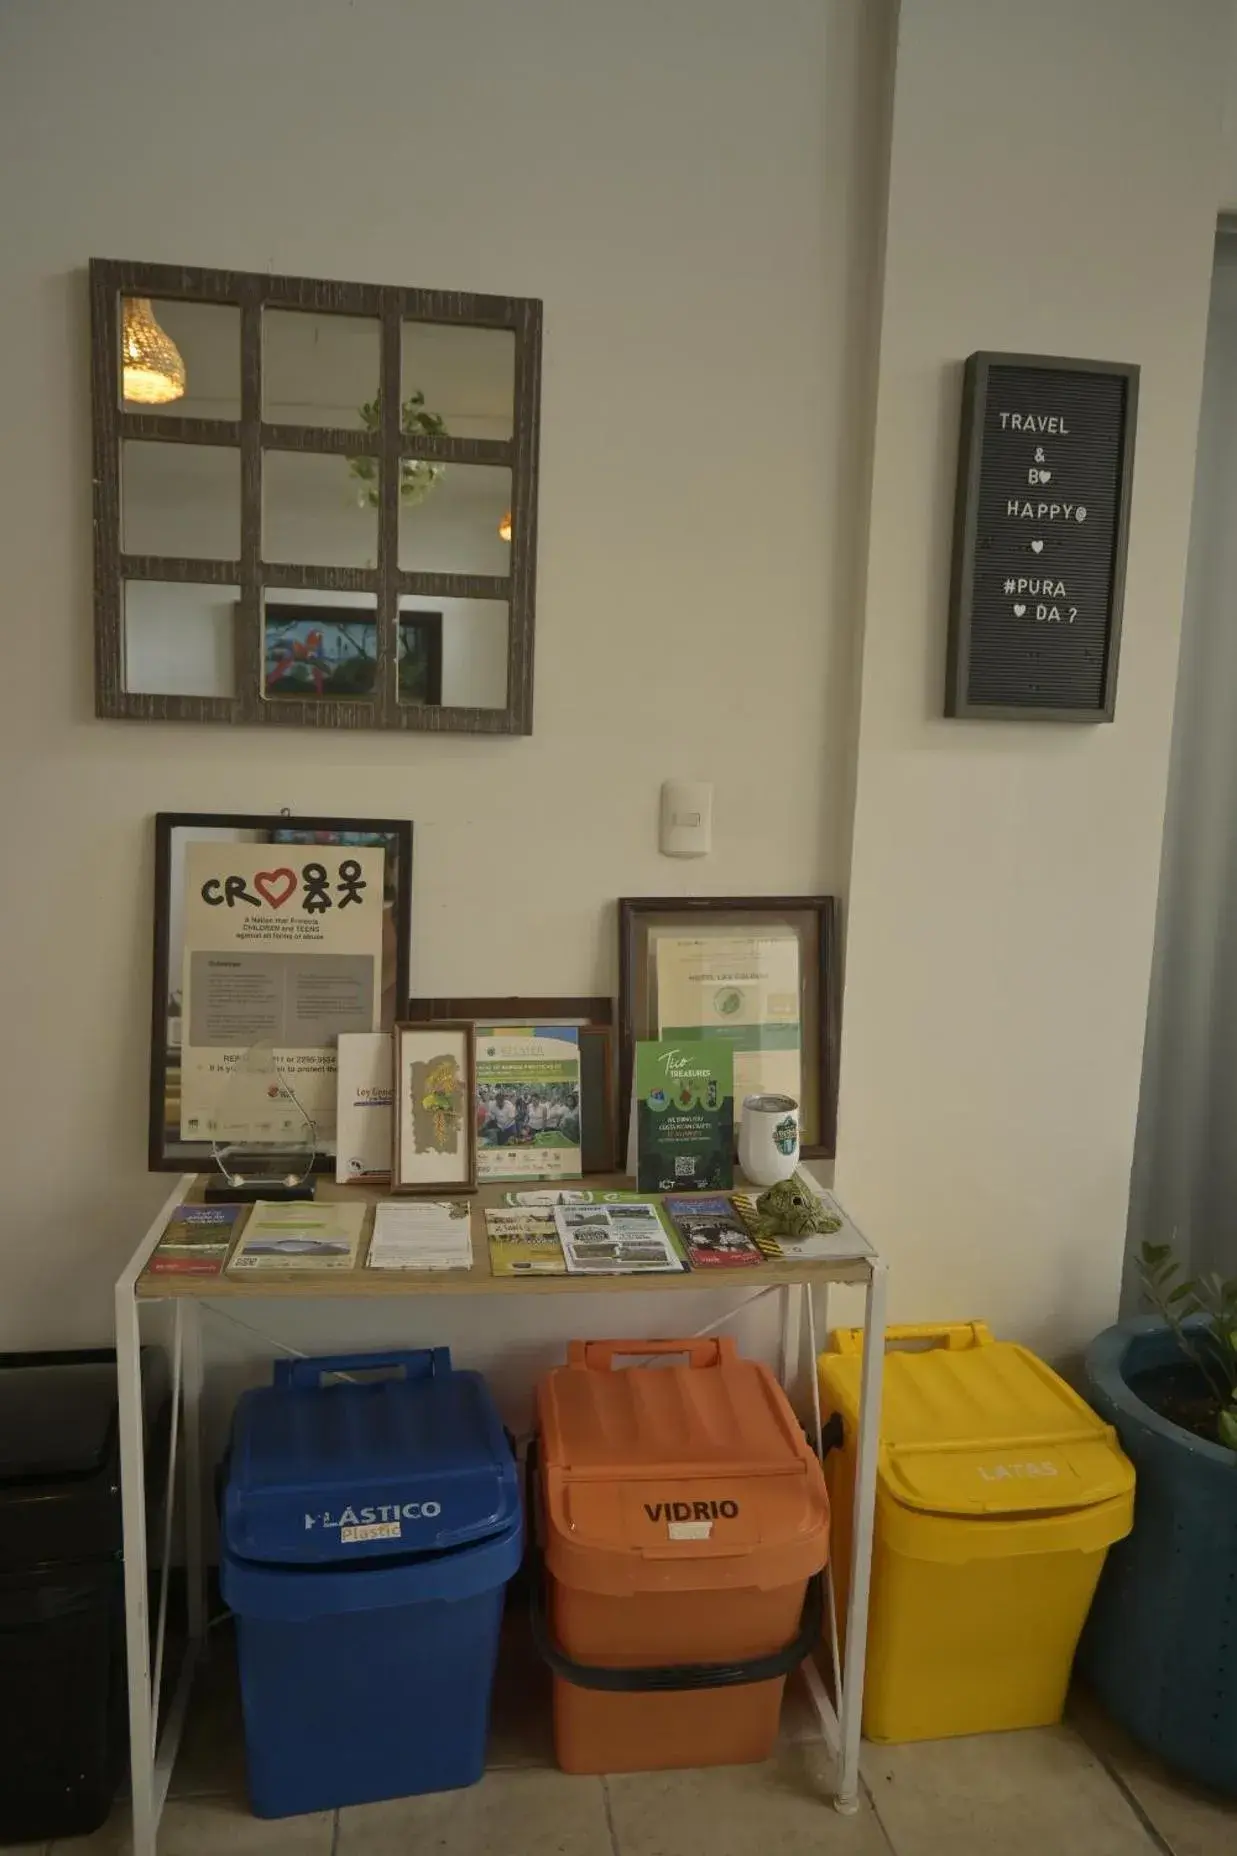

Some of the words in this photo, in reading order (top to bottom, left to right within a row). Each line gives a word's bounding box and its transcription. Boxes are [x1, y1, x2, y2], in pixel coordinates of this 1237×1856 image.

[1000, 412, 1070, 434] TRAVEL
[1034, 447, 1045, 462] &
[1003, 578, 1066, 597] #PURA
[658, 1050, 693, 1076] Tico
[643, 1499, 739, 1522] VIDRIO
